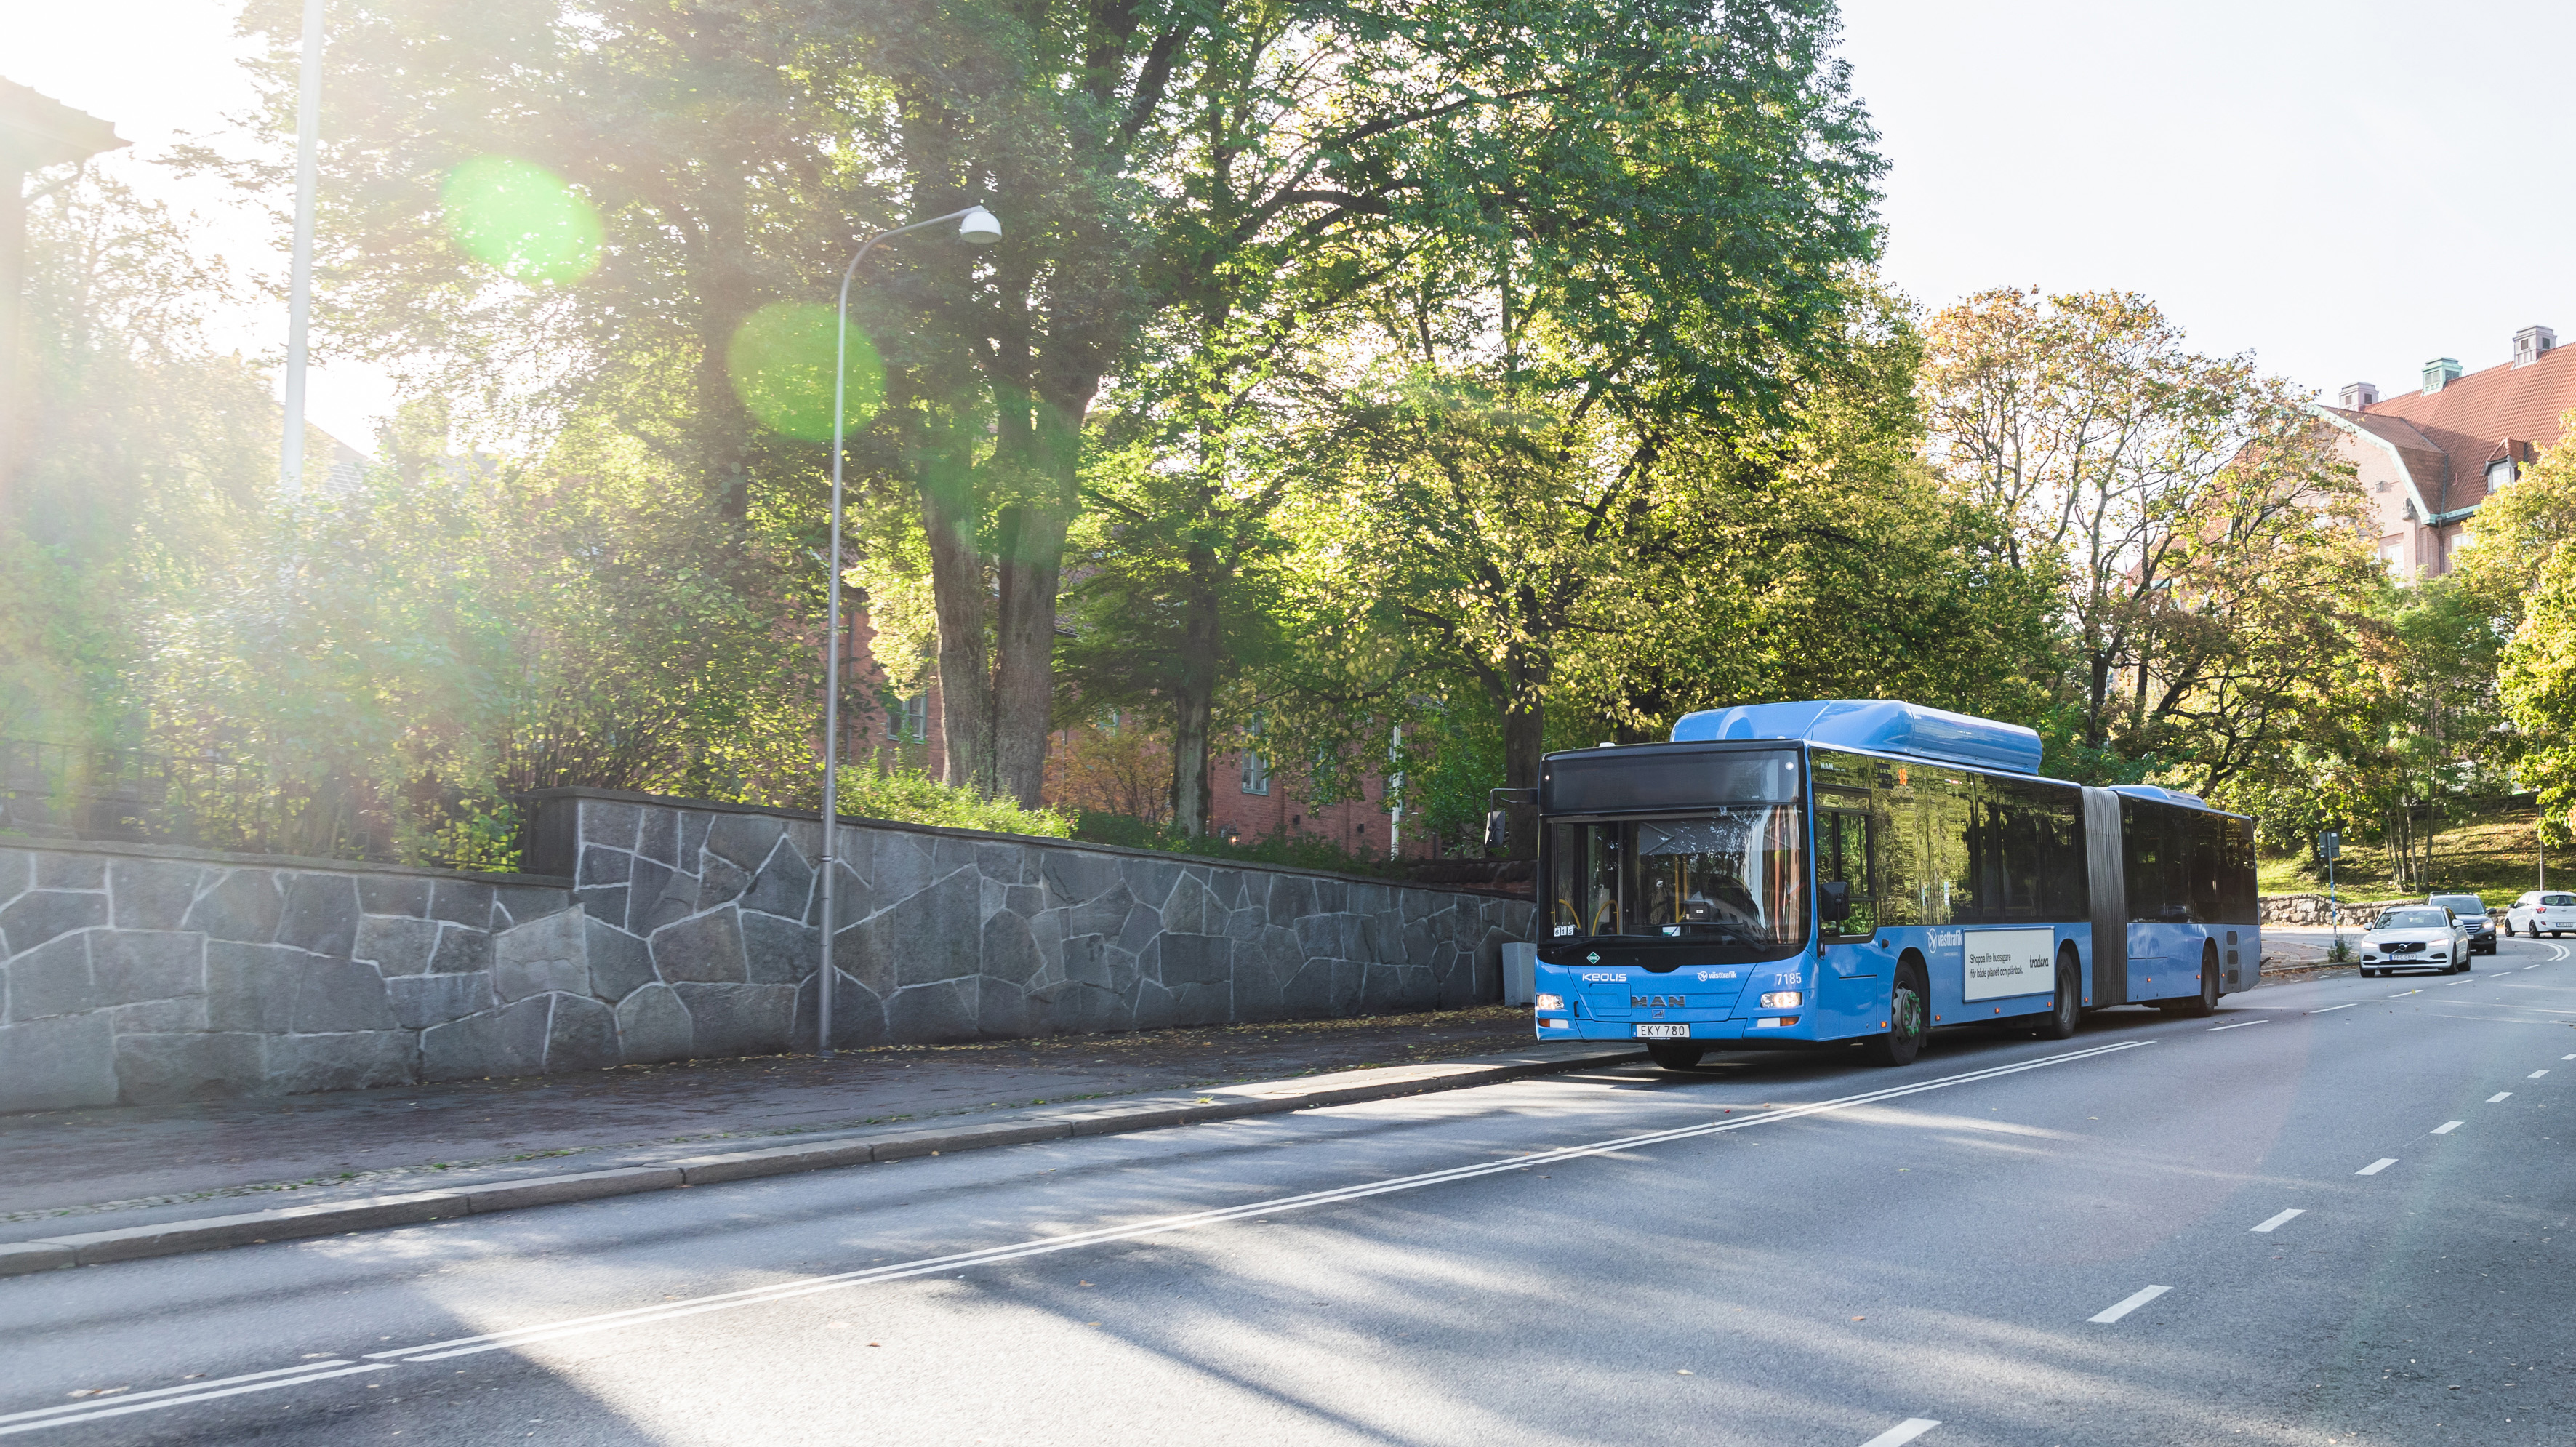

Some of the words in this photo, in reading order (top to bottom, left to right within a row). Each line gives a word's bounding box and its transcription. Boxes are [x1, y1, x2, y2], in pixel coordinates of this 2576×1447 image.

[1820, 761, 1834, 770] MAN
[1937, 929, 1963, 947] västtrafik
[1970, 953, 1986, 966] Shoppa
[1992, 952, 2011, 964] bussigare
[2029, 954, 2049, 969] tradera
[1582, 973, 1627, 982] KEOLIS
[1708, 971, 1737, 979] västtrafik
[1776, 972, 1802, 985] 7185
[1977, 968, 1986, 978] både
[1987, 967, 1999, 979] planet
[2007, 965, 2023, 977] plånbok.
[1631, 995, 1685, 1008] MAN
[1640, 1025, 1661, 1036] EKY
[1664, 1025, 1685, 1036] 780
